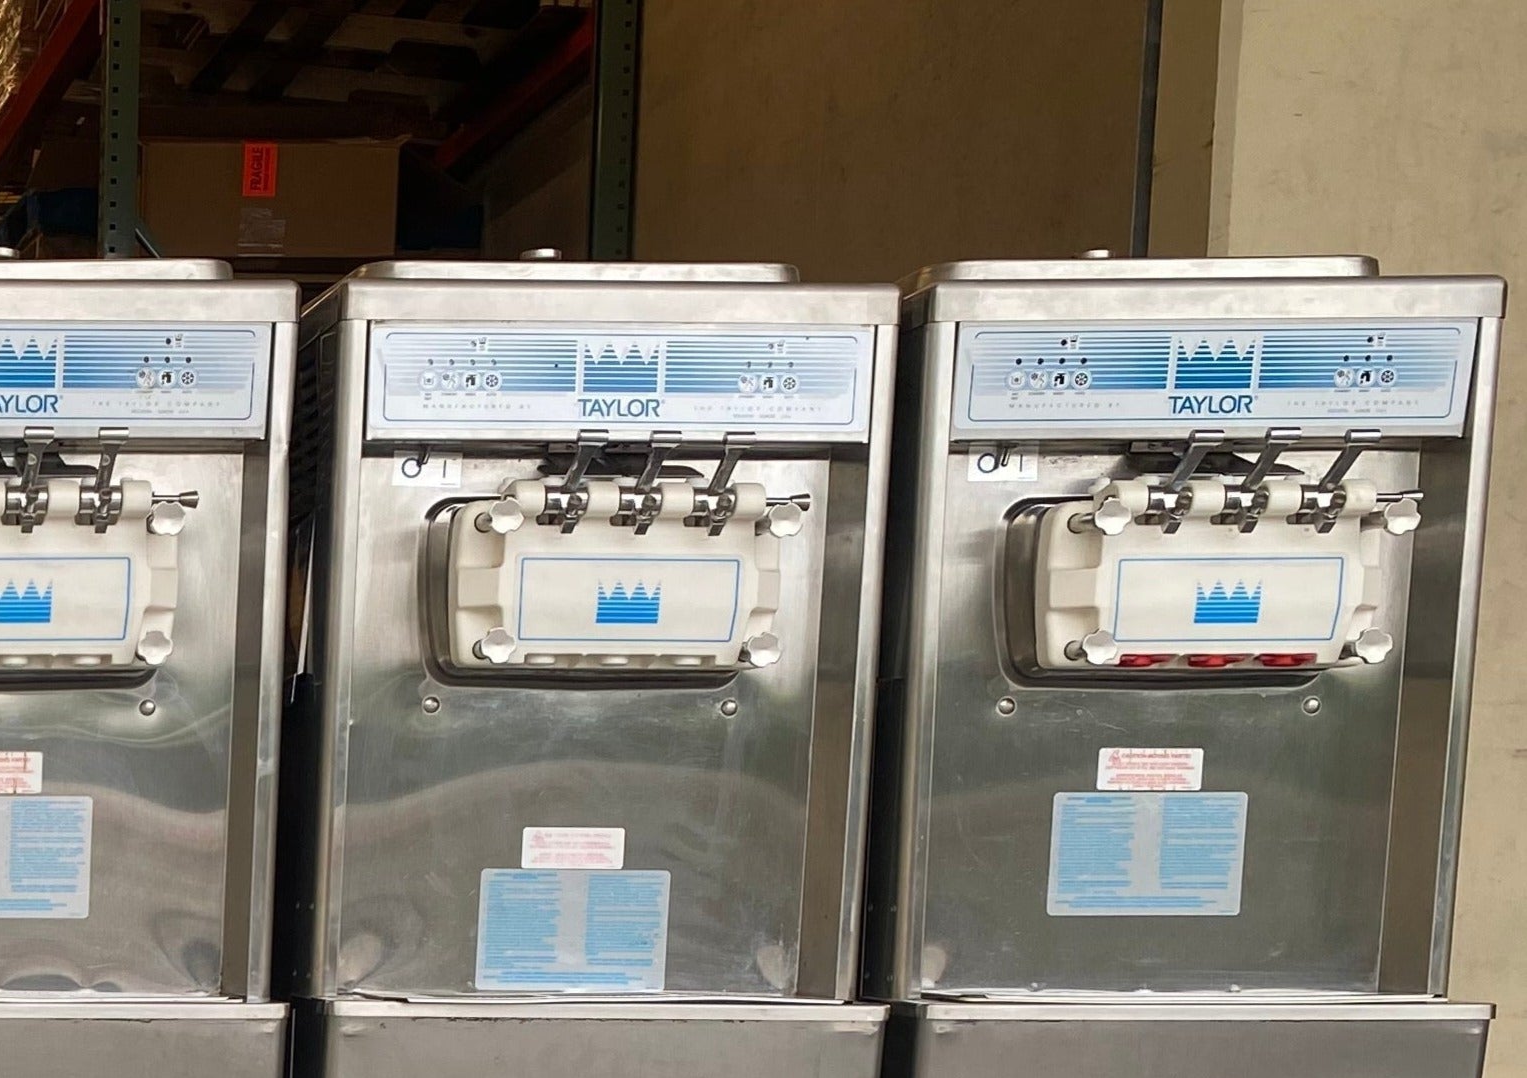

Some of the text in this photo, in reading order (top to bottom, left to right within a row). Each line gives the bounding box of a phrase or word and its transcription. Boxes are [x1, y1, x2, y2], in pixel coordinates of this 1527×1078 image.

[250, 147, 263, 191] FRAGILE
[577, 398, 660, 417] TAYLOR
[1168, 394, 1253, 414] TAYLOR
